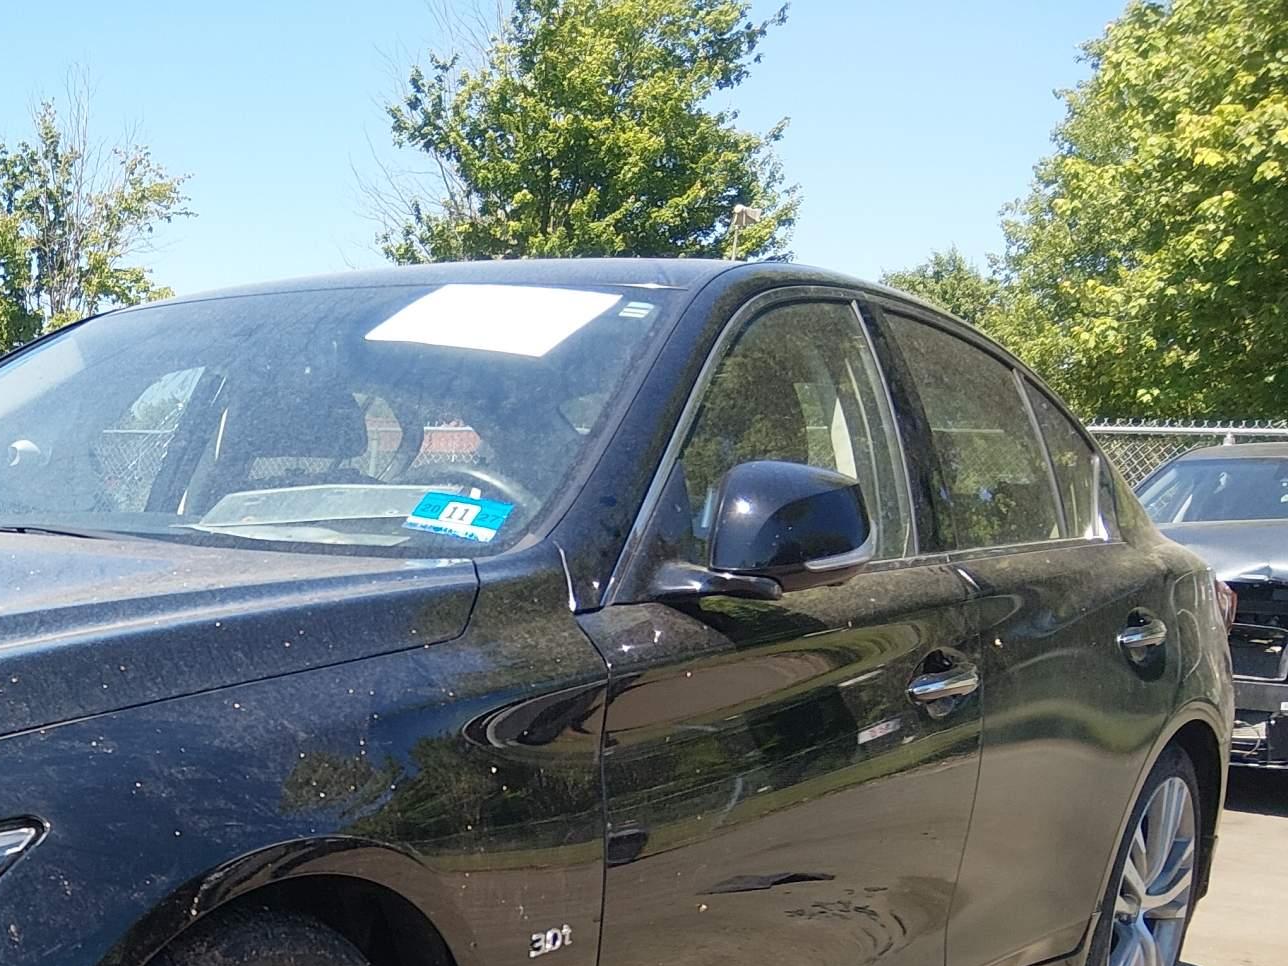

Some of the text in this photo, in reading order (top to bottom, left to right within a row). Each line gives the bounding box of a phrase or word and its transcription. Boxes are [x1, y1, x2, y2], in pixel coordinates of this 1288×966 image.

[421, 503, 501, 523] 20 11 27
